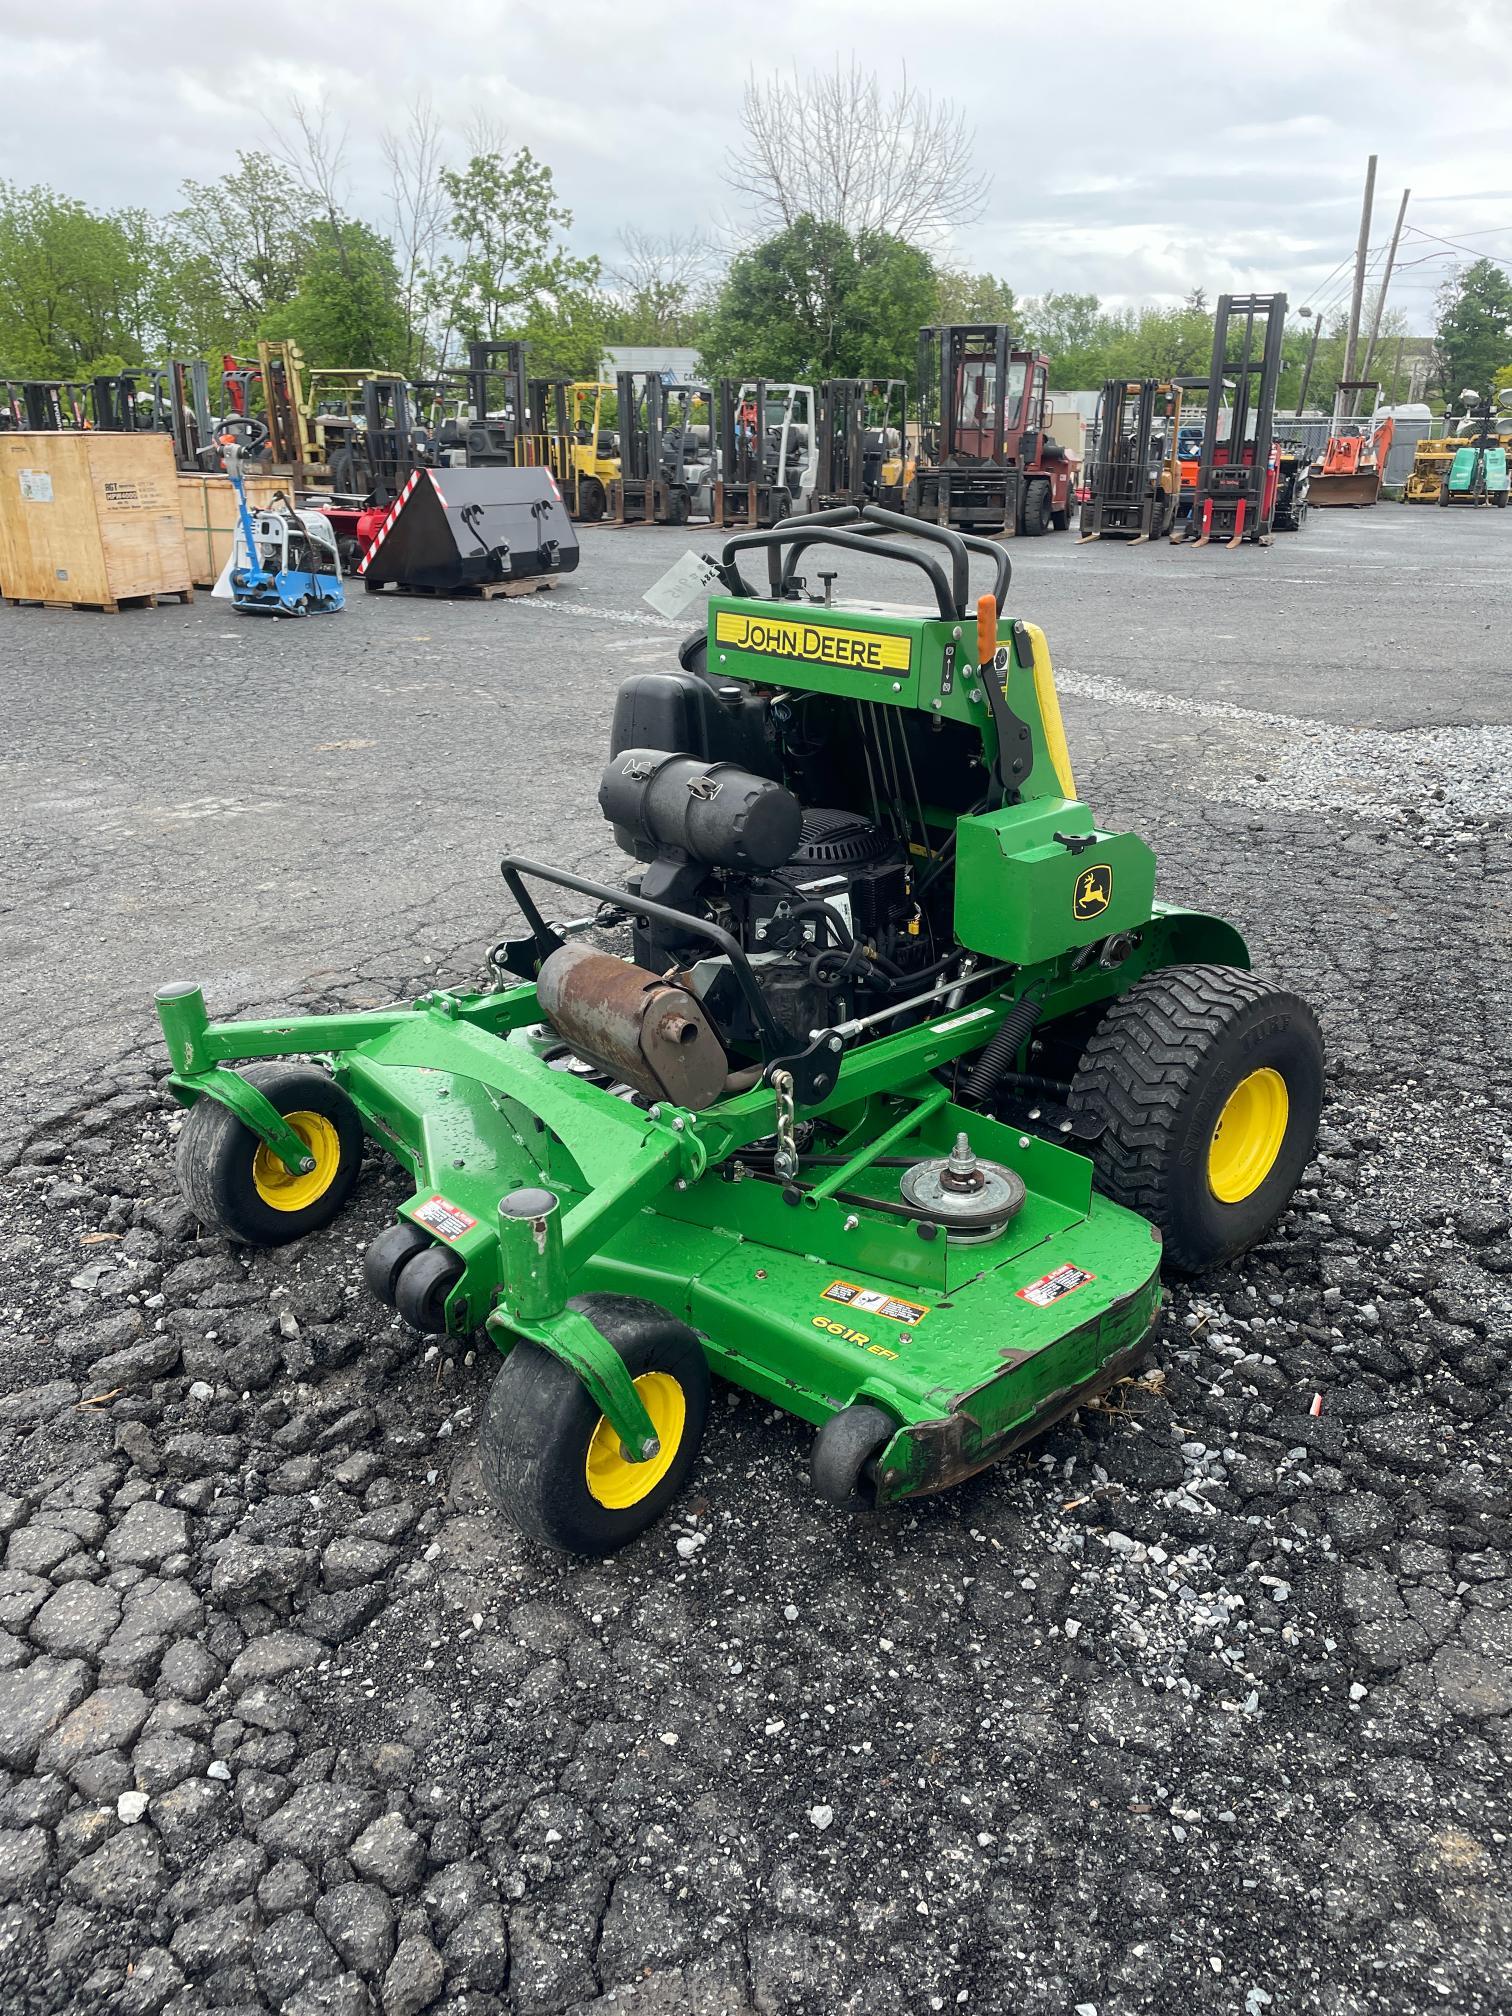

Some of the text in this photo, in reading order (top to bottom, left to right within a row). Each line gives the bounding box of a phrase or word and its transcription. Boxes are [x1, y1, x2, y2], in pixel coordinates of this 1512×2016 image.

[737, 619, 882, 666] JOHN DEERE
[811, 1315, 900, 1361] 661R EFI
